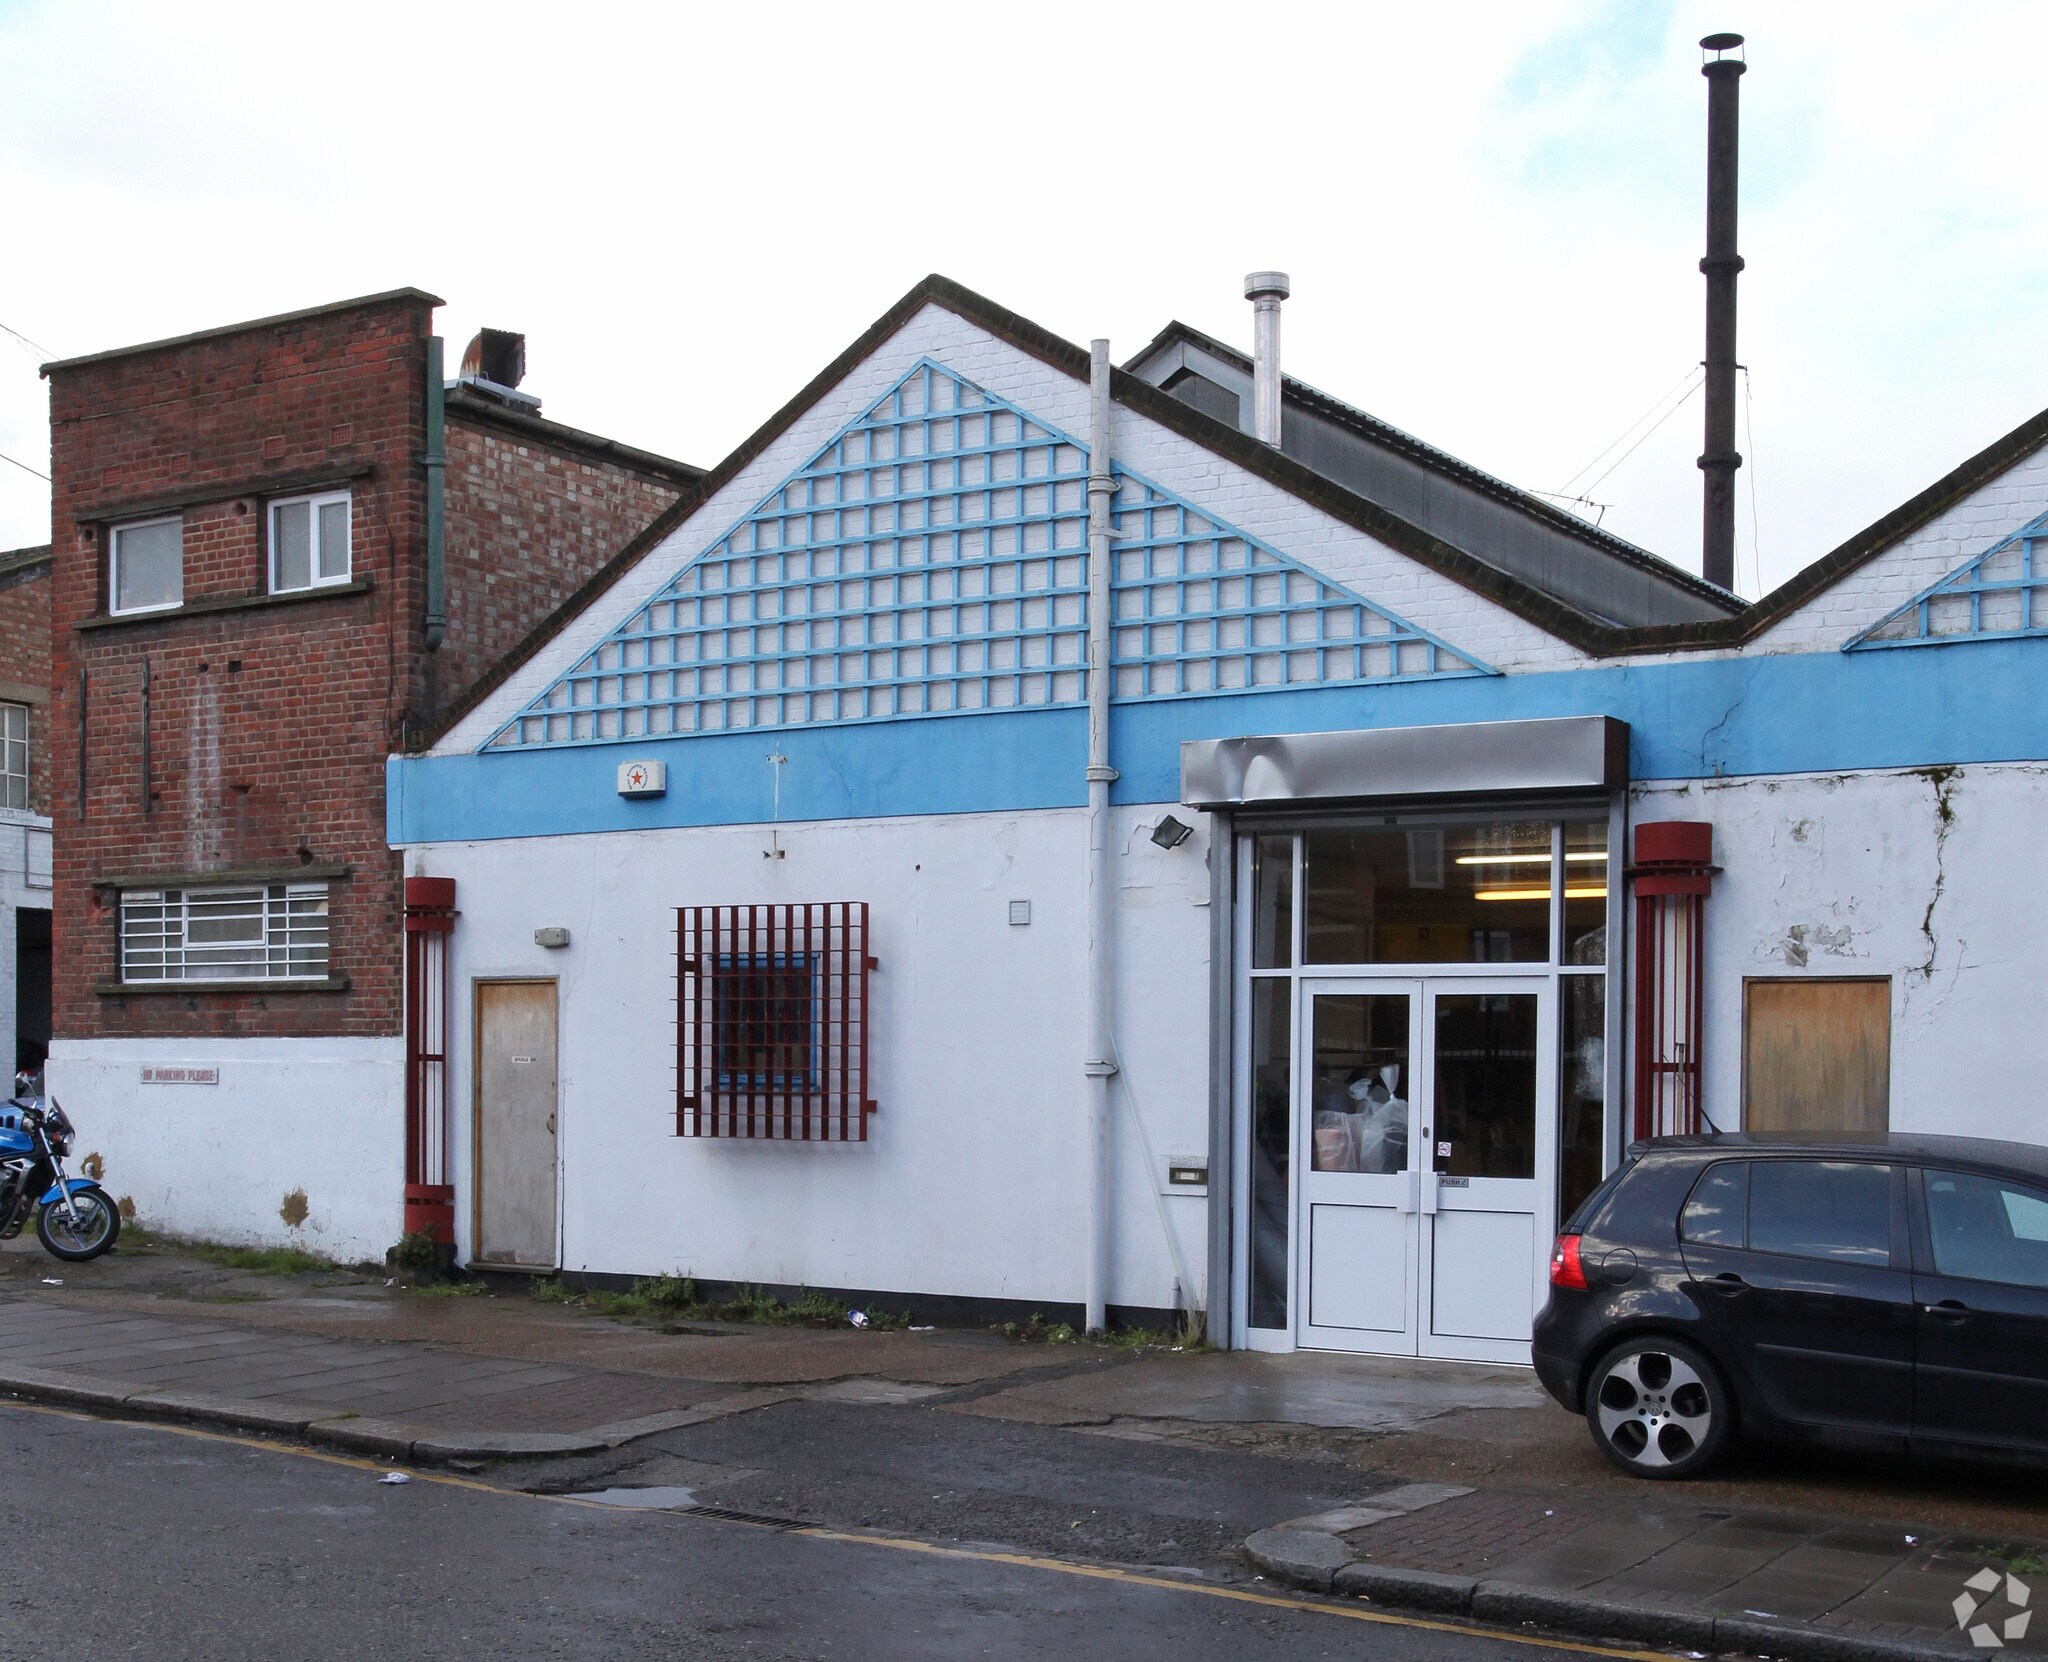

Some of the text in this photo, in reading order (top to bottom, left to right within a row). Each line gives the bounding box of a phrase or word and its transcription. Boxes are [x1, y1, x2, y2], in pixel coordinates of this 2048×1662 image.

[143, 1069, 213, 1081] NO PARKING PLEASE
